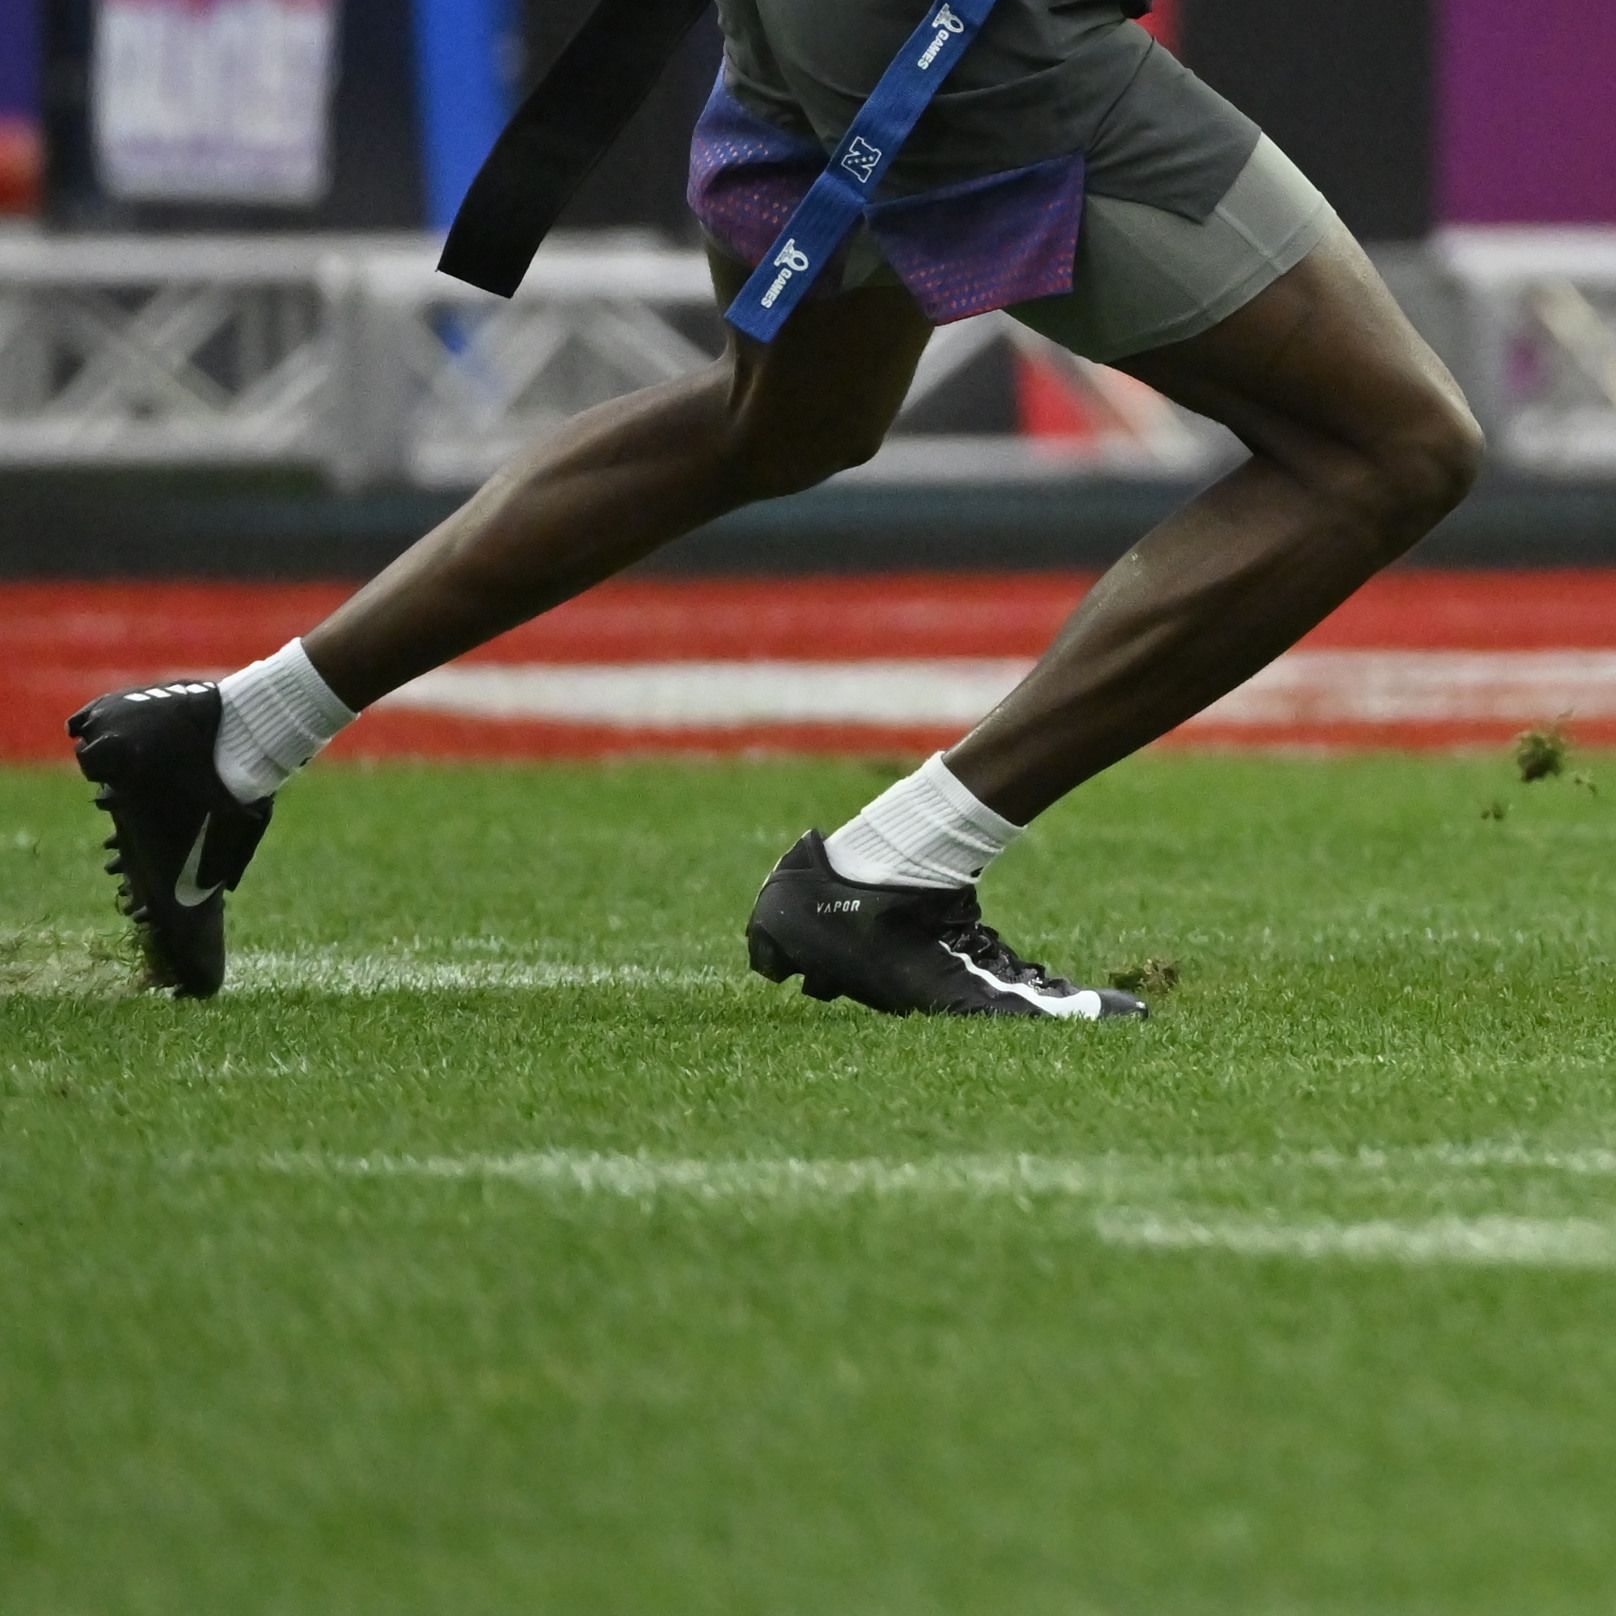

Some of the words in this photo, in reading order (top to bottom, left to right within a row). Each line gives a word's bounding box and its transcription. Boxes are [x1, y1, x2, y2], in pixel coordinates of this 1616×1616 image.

[917, 29, 950, 70] GAMES
[760, 267, 793, 308] GAMES
[816, 899, 861, 913] VAPOR
